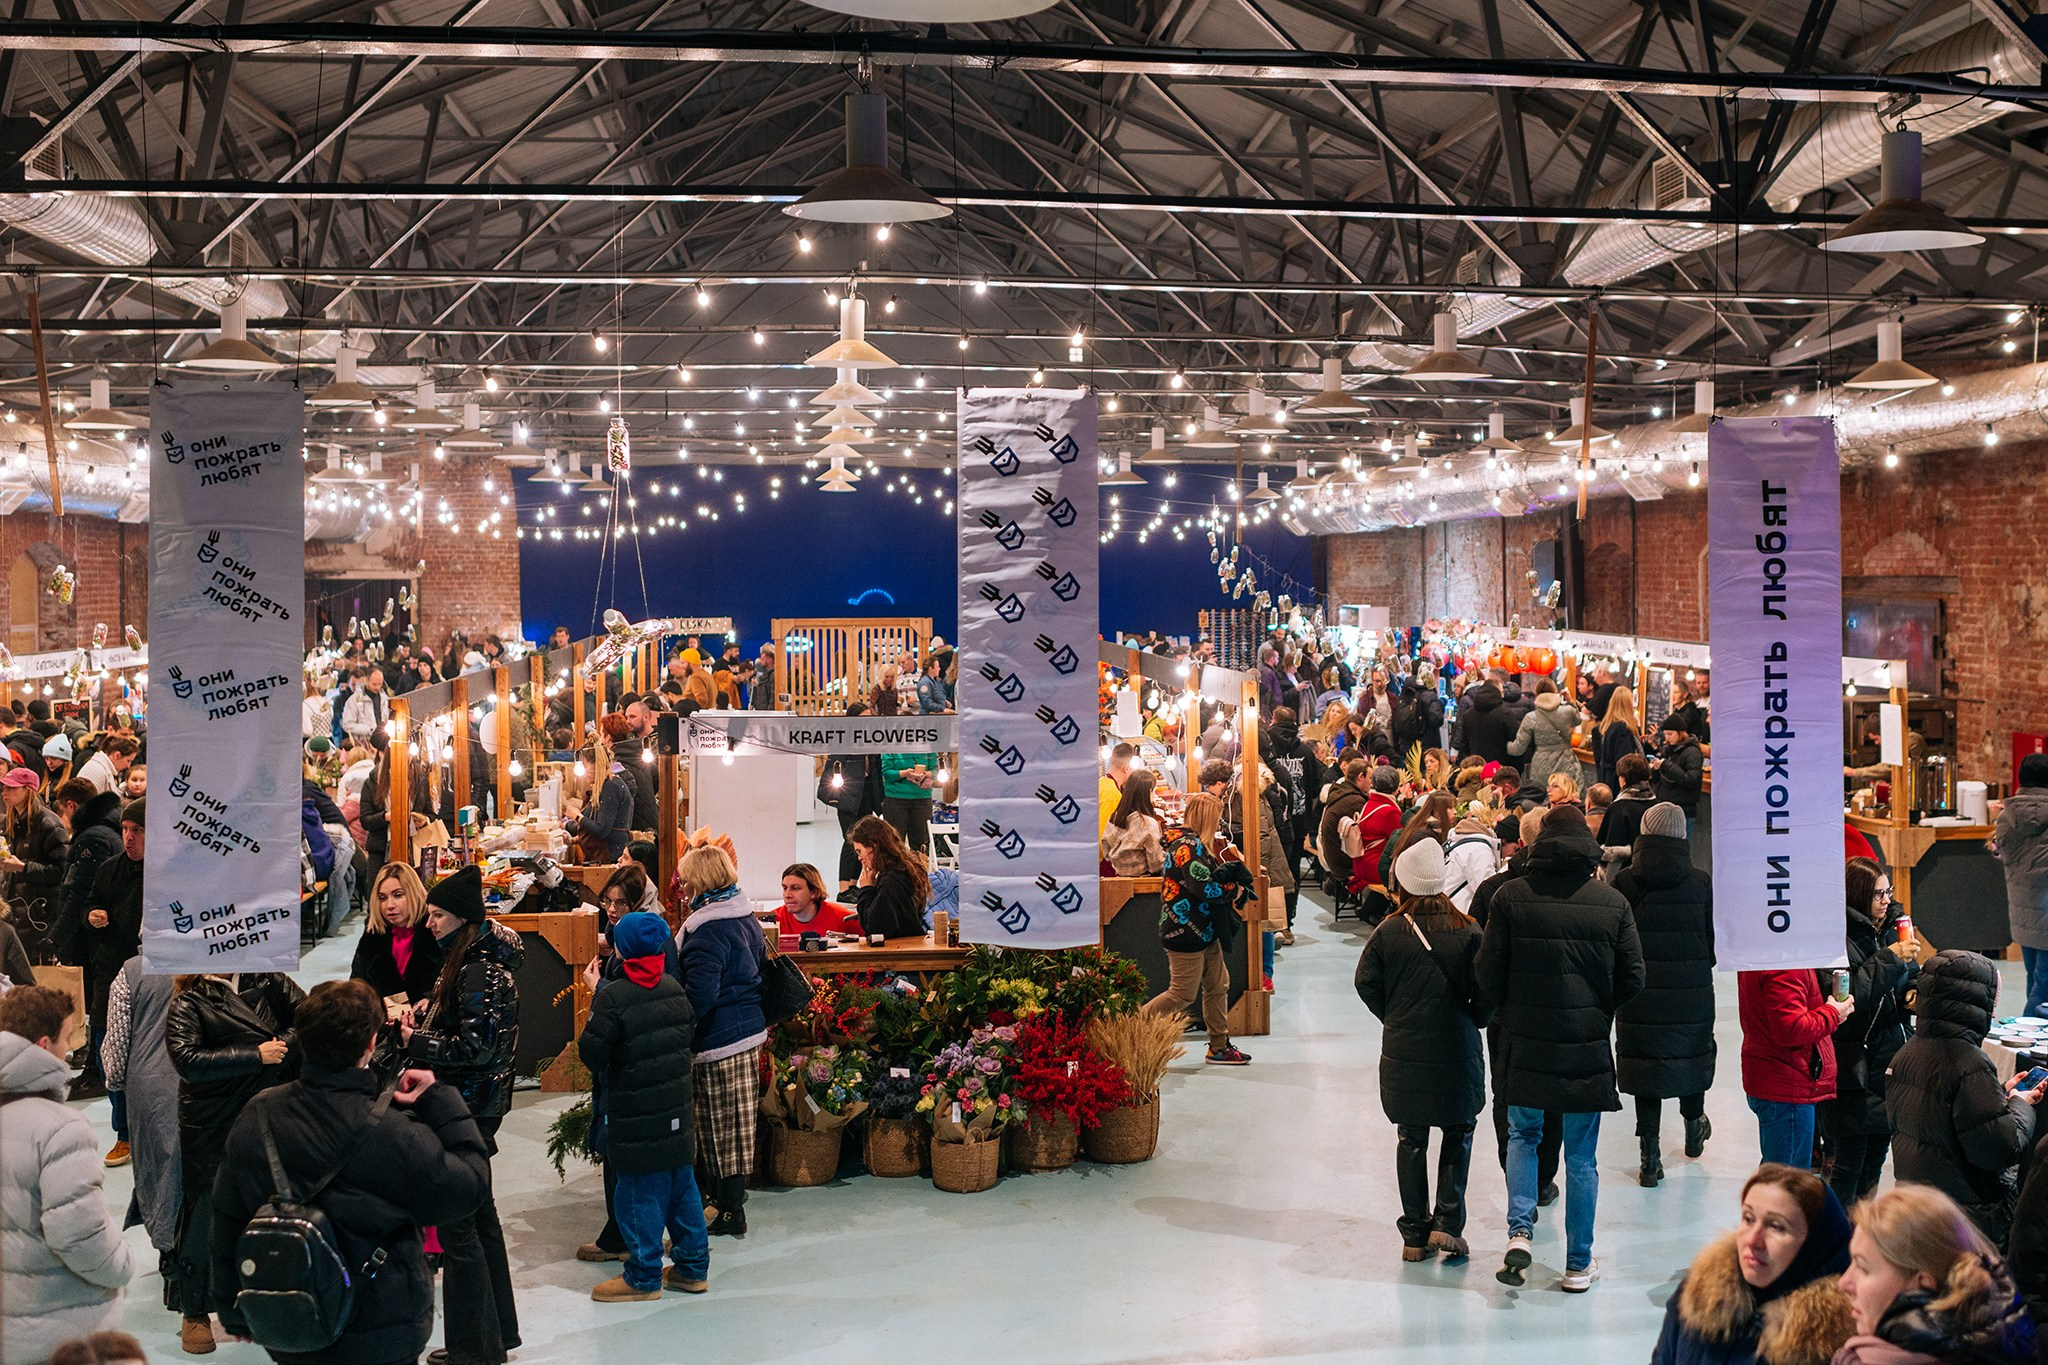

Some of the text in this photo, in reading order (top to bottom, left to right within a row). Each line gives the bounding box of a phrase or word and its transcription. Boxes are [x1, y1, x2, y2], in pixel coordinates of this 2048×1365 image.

[190, 436, 227, 453] они
[194, 441, 281, 470] пожрать
[201, 463, 262, 487] любят
[222, 557, 257, 581] они
[203, 587, 263, 623] любят
[211, 570, 290, 621] пожрать
[199, 669, 235, 687] они
[202, 675, 289, 704] пожрать
[208, 696, 270, 721] любят
[1755, 478, 1795, 934] они пожрать любят
[789, 729, 938, 744] KRAFT FLOWERS
[193, 790, 228, 815] они
[173, 820, 234, 857] любят
[182, 804, 261, 854] пожрать
[200, 903, 236, 922] они
[203, 908, 291, 939] пожрать
[208, 929, 270, 956] любят
